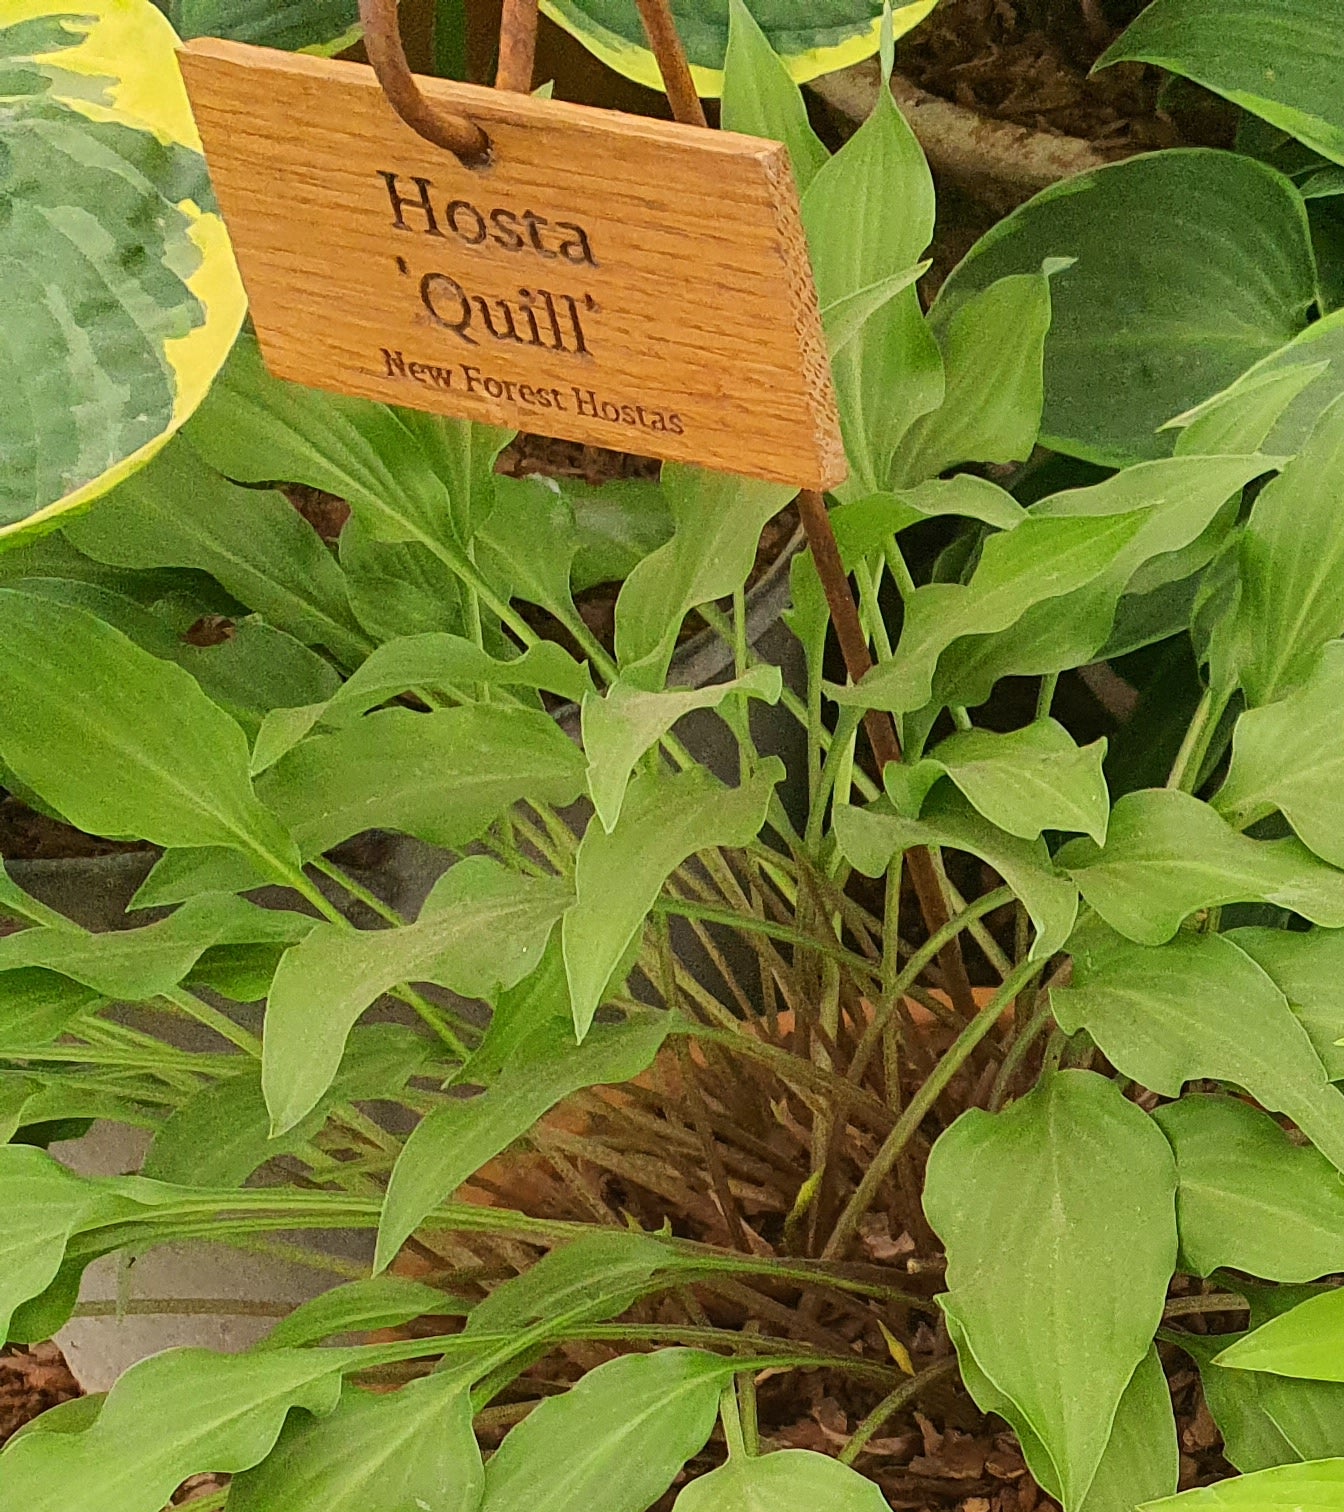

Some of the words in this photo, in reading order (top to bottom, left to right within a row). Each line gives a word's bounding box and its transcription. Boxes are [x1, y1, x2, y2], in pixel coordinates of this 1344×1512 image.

[376, 168, 600, 269] Hosta
[396, 255, 600, 359] 'Quill'
[379, 347, 453, 389] New
[459, 362, 568, 412] Forest
[570, 386, 685, 436] Hostas
